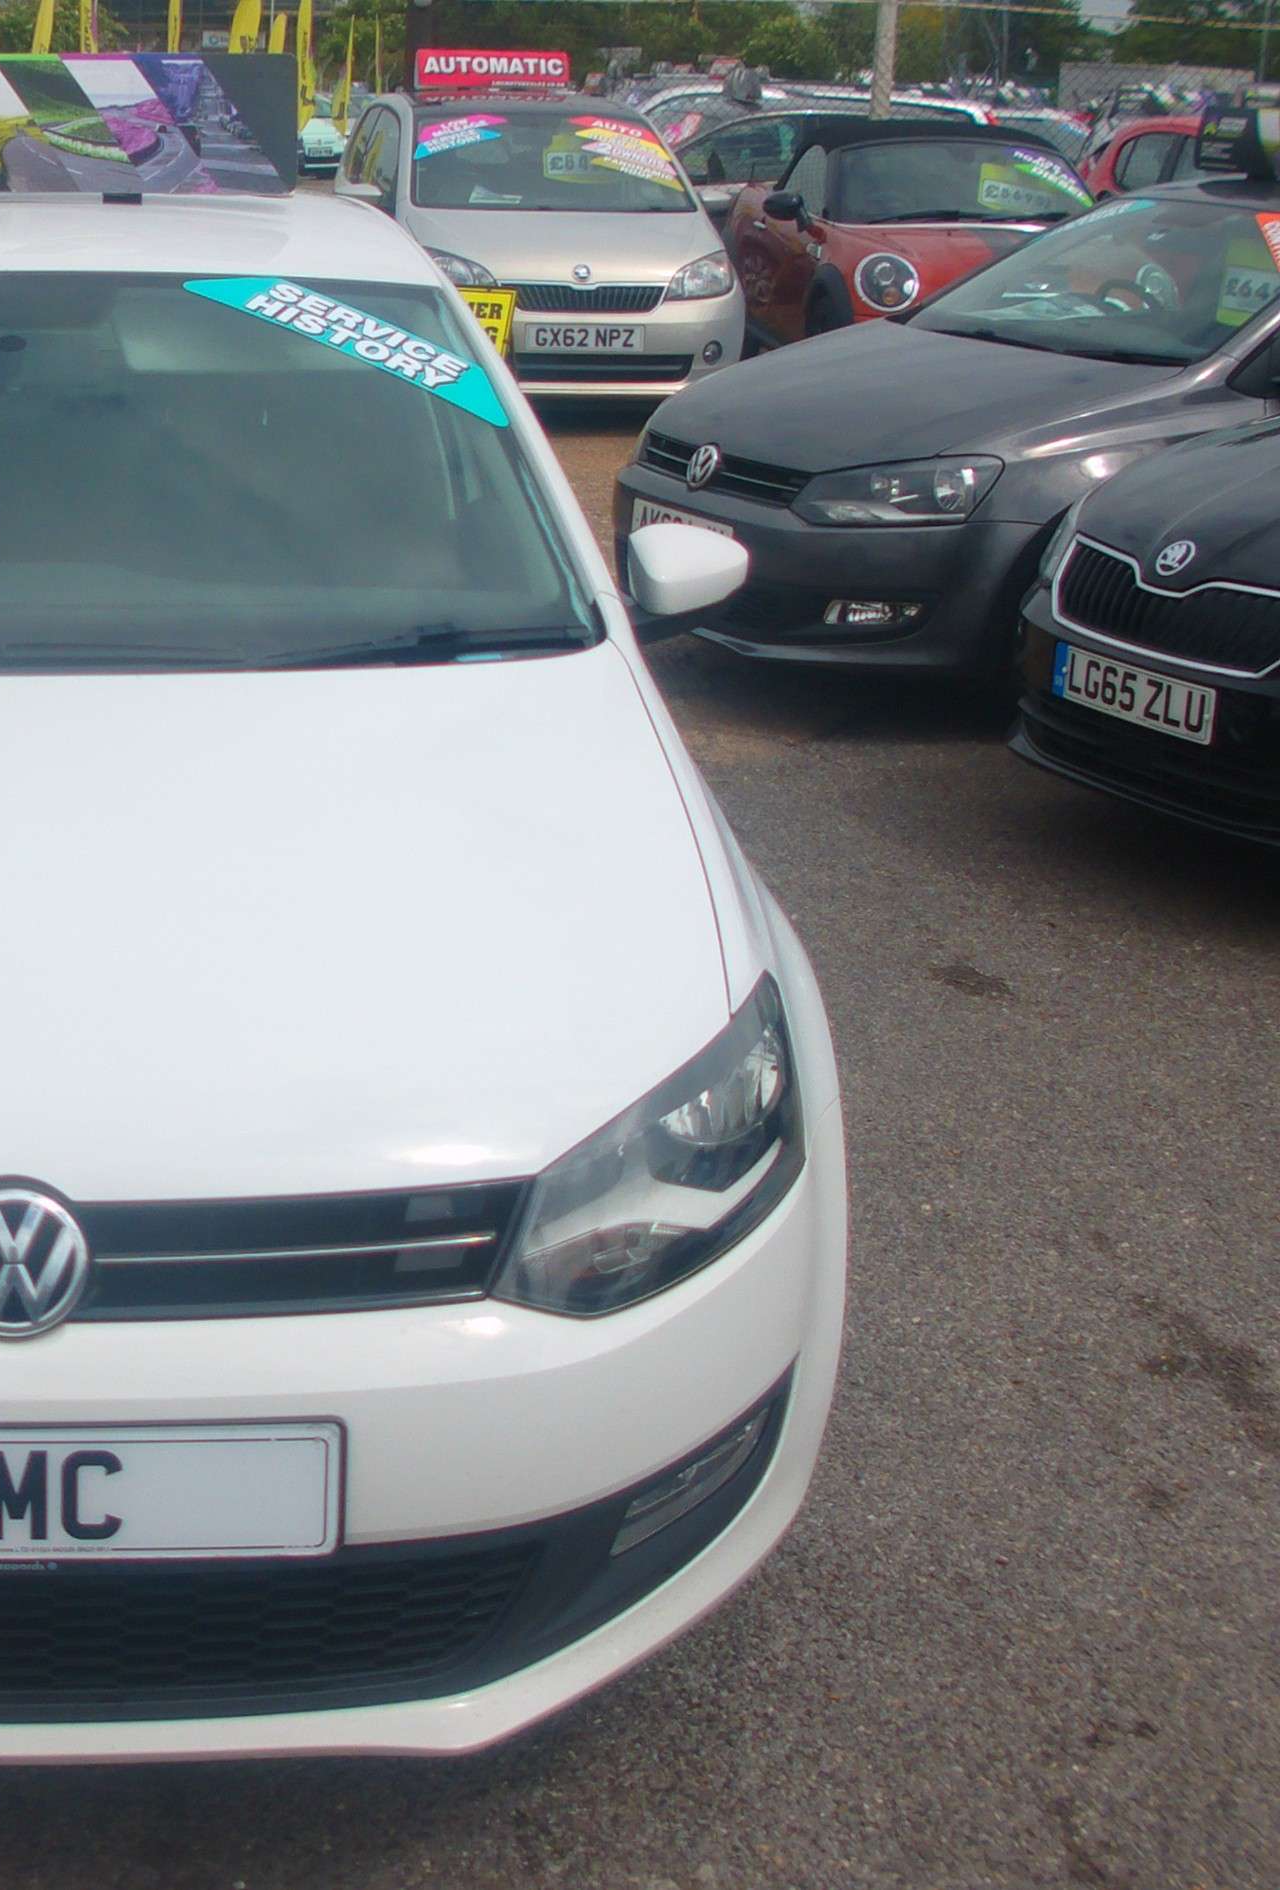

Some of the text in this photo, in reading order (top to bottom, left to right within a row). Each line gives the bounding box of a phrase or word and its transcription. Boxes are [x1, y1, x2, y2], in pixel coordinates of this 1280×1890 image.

[423, 56, 564, 76] AUTOMATIC
[592, 120, 642, 137] AUTO
[243, 292, 458, 390] HISTORY
[268, 282, 470, 380] SERVICE
[534, 328, 635, 348] GX62 NPZ
[1067, 653, 1206, 733] LG65 ZLU
